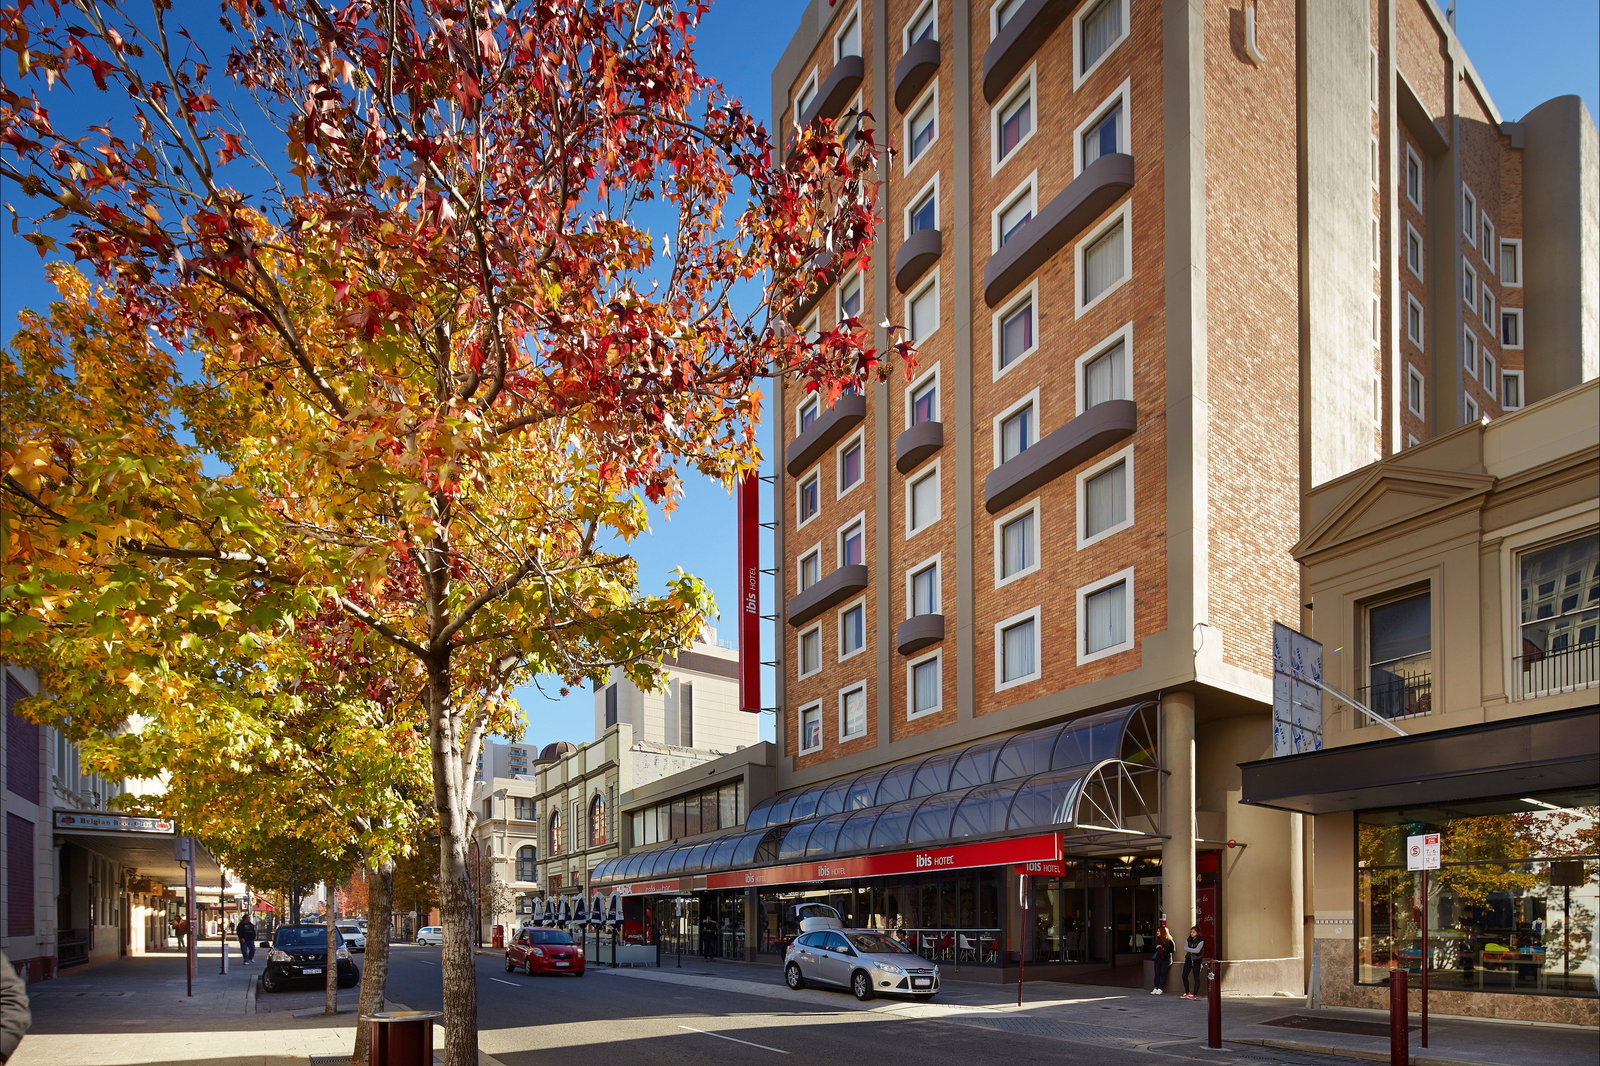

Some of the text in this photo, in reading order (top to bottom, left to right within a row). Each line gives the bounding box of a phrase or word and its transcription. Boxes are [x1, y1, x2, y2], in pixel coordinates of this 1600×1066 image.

[745, 567, 757, 614] ibis HOTEL
[80, 817, 111, 826] Belgian
[114, 819, 130, 827] Beer
[916, 853, 955, 868] ibis HOTEL
[818, 865, 846, 877] ibis HOTEL
[1043, 864, 1061, 873] HOTEL
[745, 873, 755, 883] ibis
